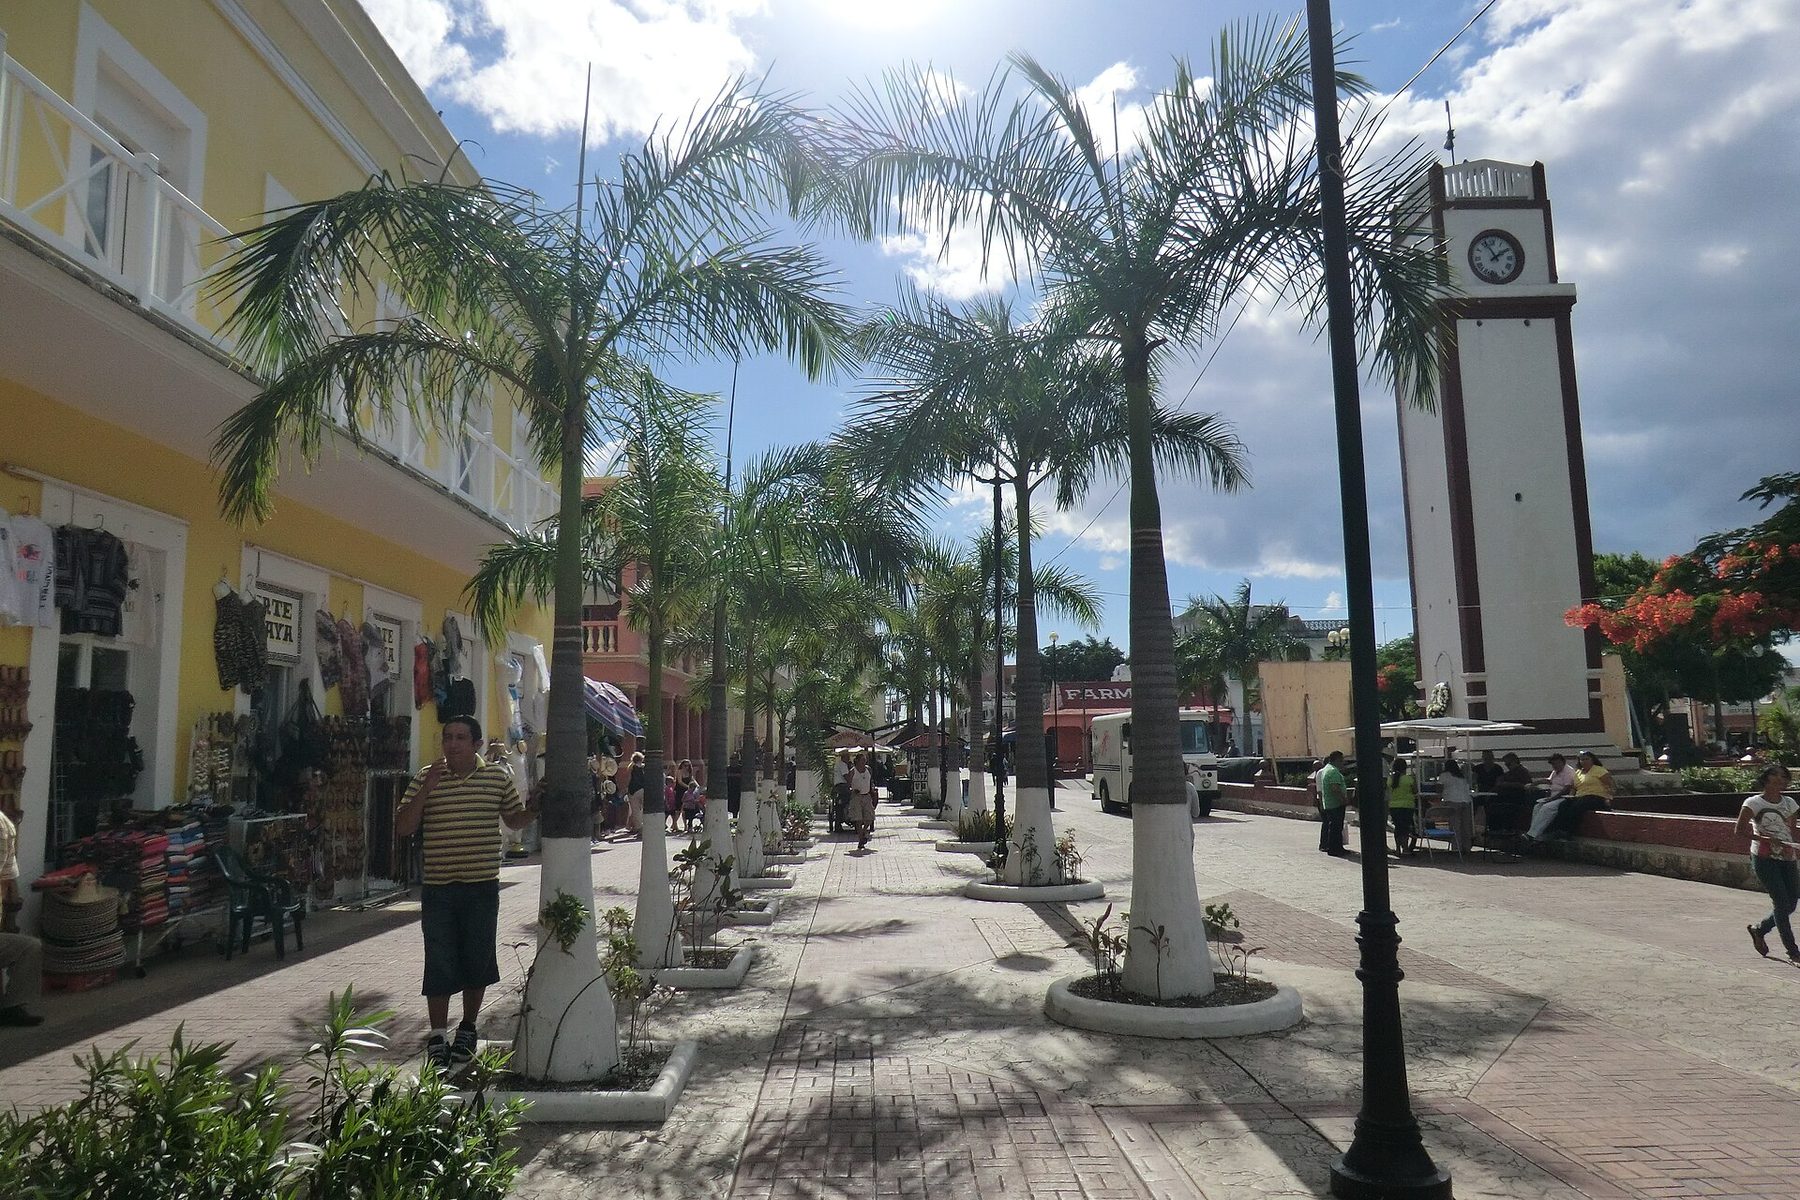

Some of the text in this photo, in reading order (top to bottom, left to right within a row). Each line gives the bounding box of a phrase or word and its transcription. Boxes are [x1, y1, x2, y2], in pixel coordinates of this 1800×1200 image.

[257, 595, 292, 620] RTE
[265, 620, 293, 643] AYA
[1065, 688, 1132, 700] FARM
